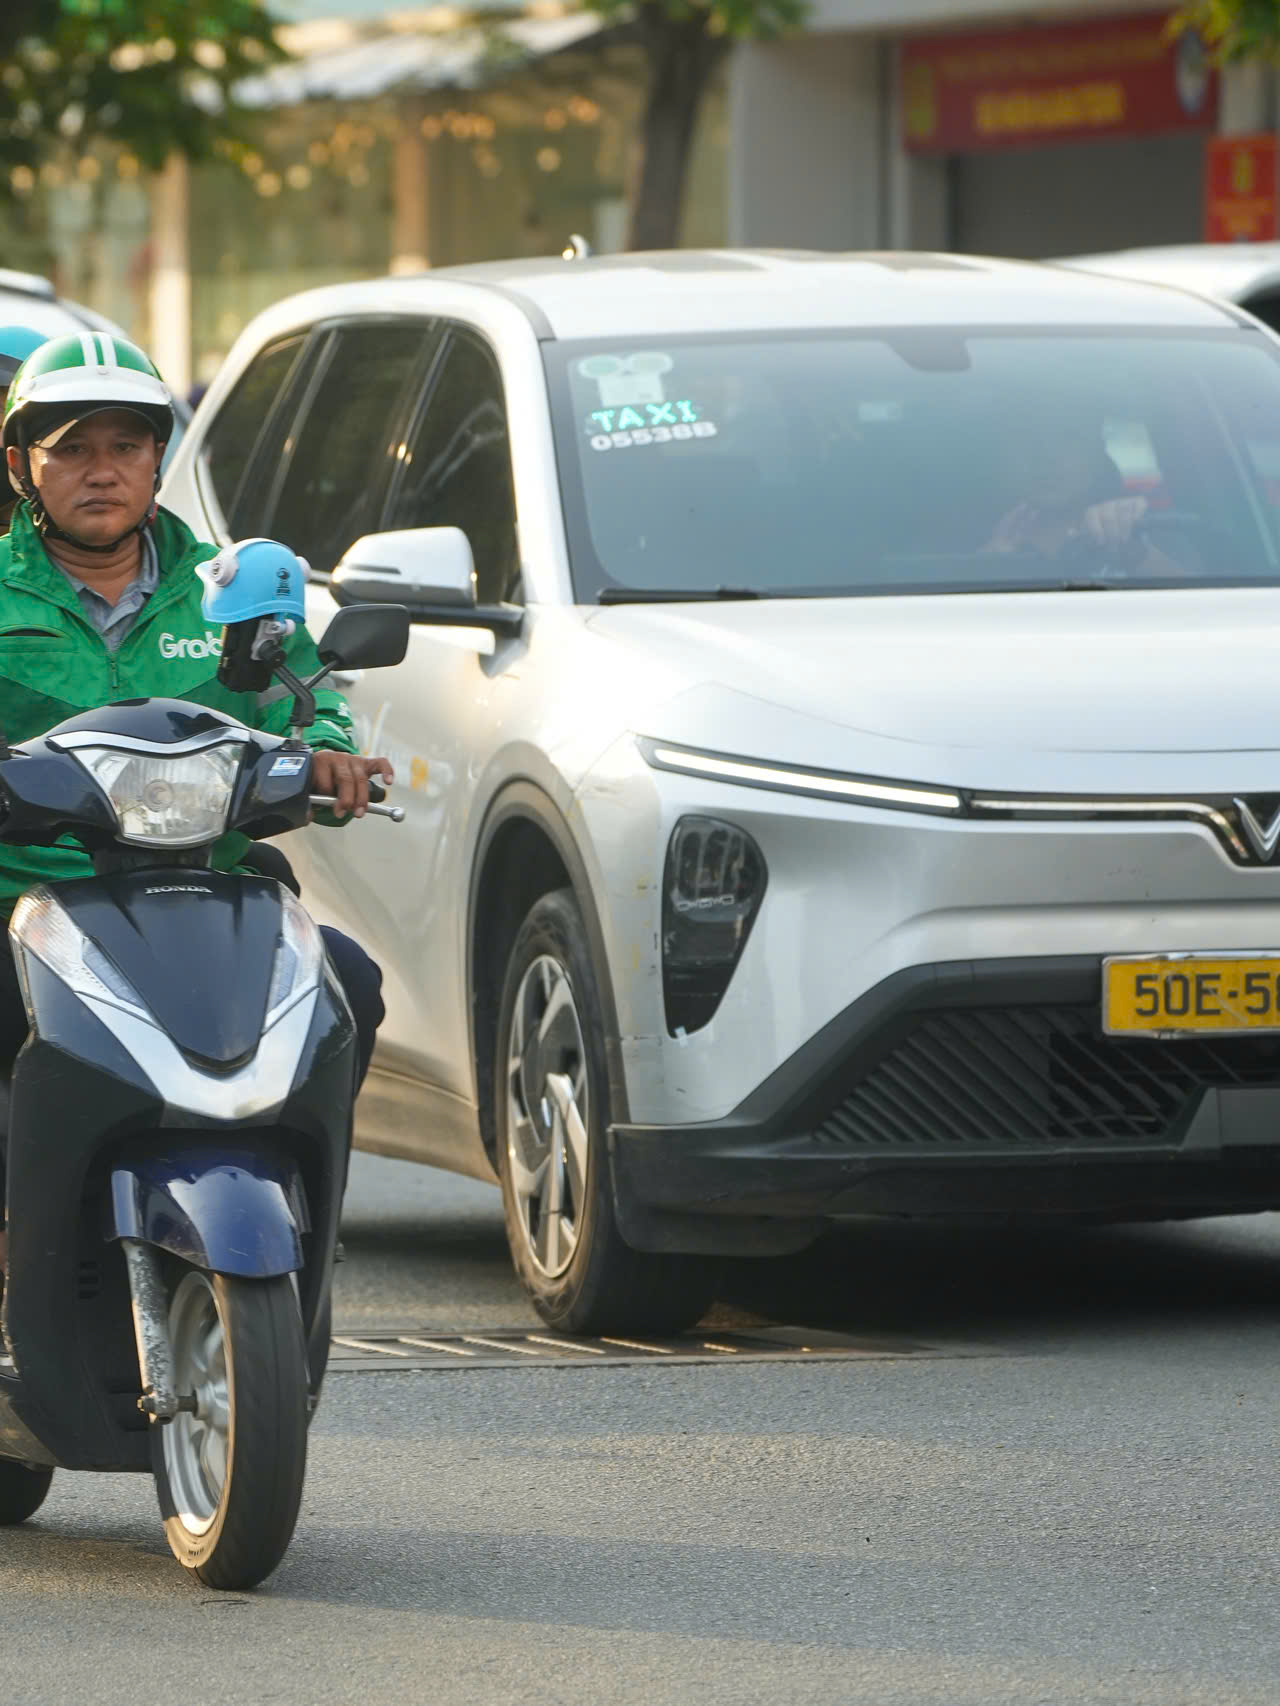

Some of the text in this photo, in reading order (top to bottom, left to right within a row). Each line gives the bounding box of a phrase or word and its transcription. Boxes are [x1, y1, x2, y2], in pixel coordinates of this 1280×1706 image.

[591, 400, 697, 432] TAXI
[159, 631, 225, 659] Grab
[144, 885, 214, 894] HONDA
[1134, 972, 1280, 1017] 50E-5
